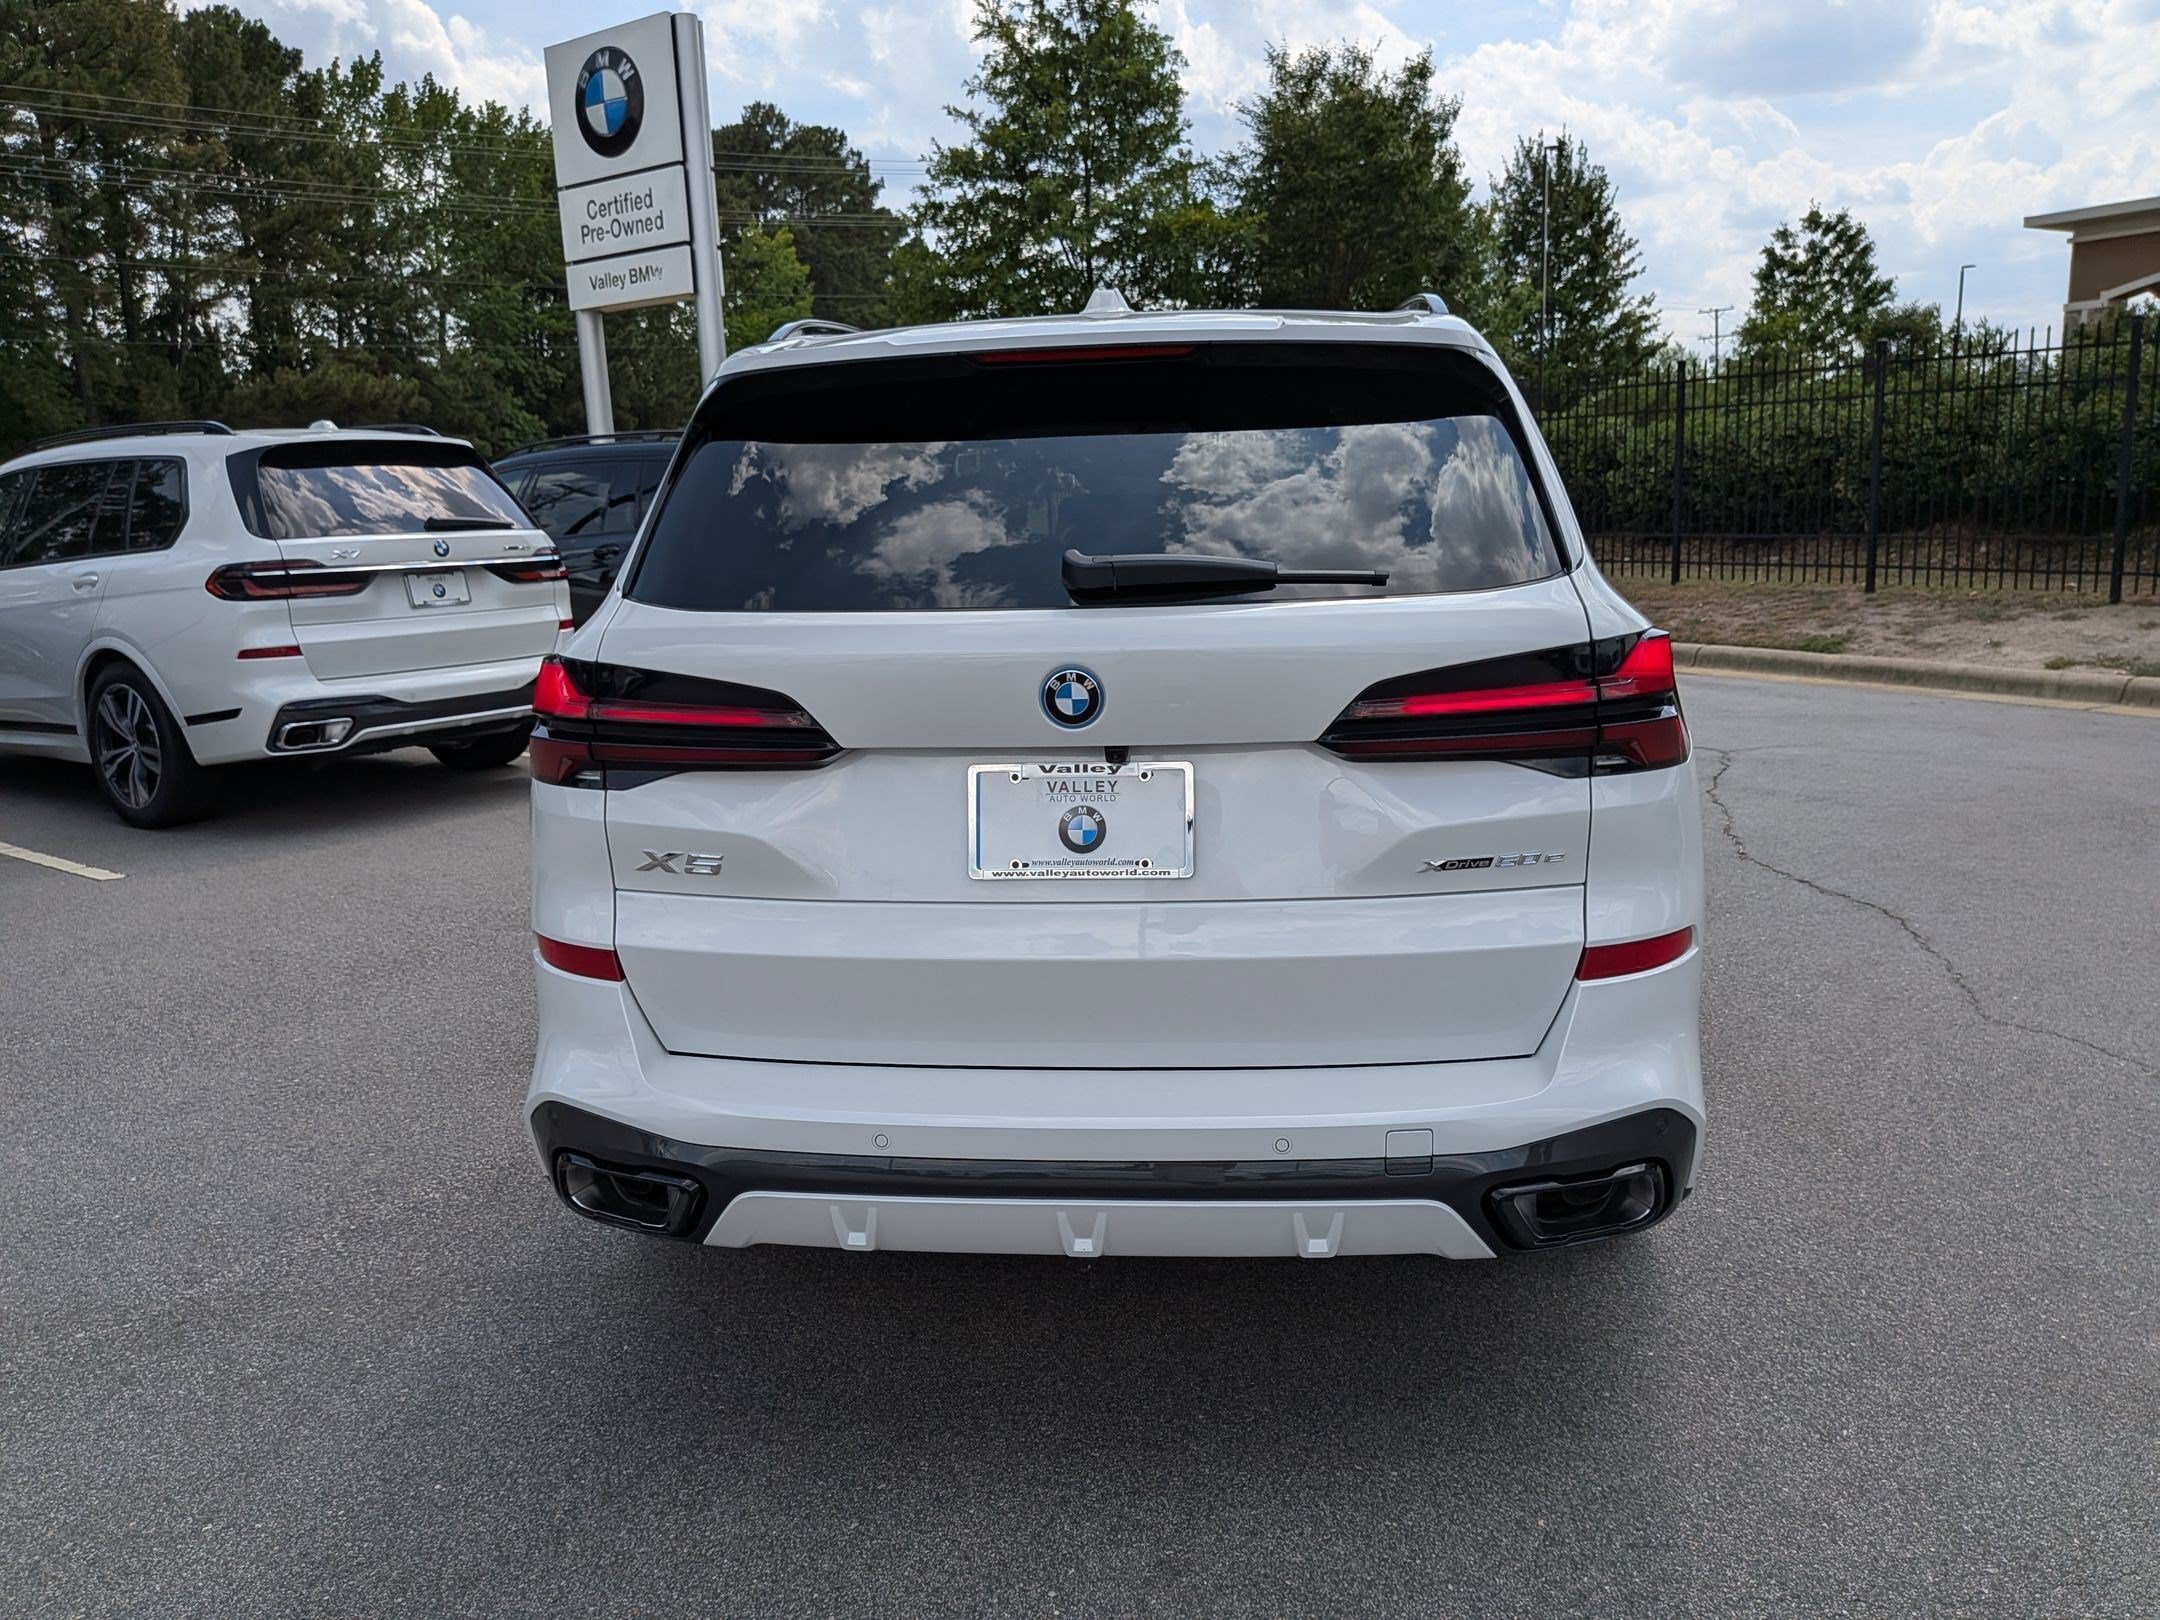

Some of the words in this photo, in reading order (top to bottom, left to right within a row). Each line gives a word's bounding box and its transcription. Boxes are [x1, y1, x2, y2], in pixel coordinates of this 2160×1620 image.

[579, 50, 635, 89] BMW
[586, 187, 654, 220] Certified
[580, 209, 665, 245] Pre-Owned
[589, 272, 627, 291] Valley
[1049, 672, 1095, 691] BMW
[1038, 764, 1121, 775] Valley
[1047, 780, 1118, 793] VALLEY
[1049, 795, 1076, 803] AUTO
[1080, 794, 1117, 802] WORLD
[1063, 807, 1102, 822] BMW
[635, 848, 724, 875] X5
[1031, 858, 1134, 868] www.valleyautoworld.com
[991, 869, 1172, 878] www.valleyautoworld.com
